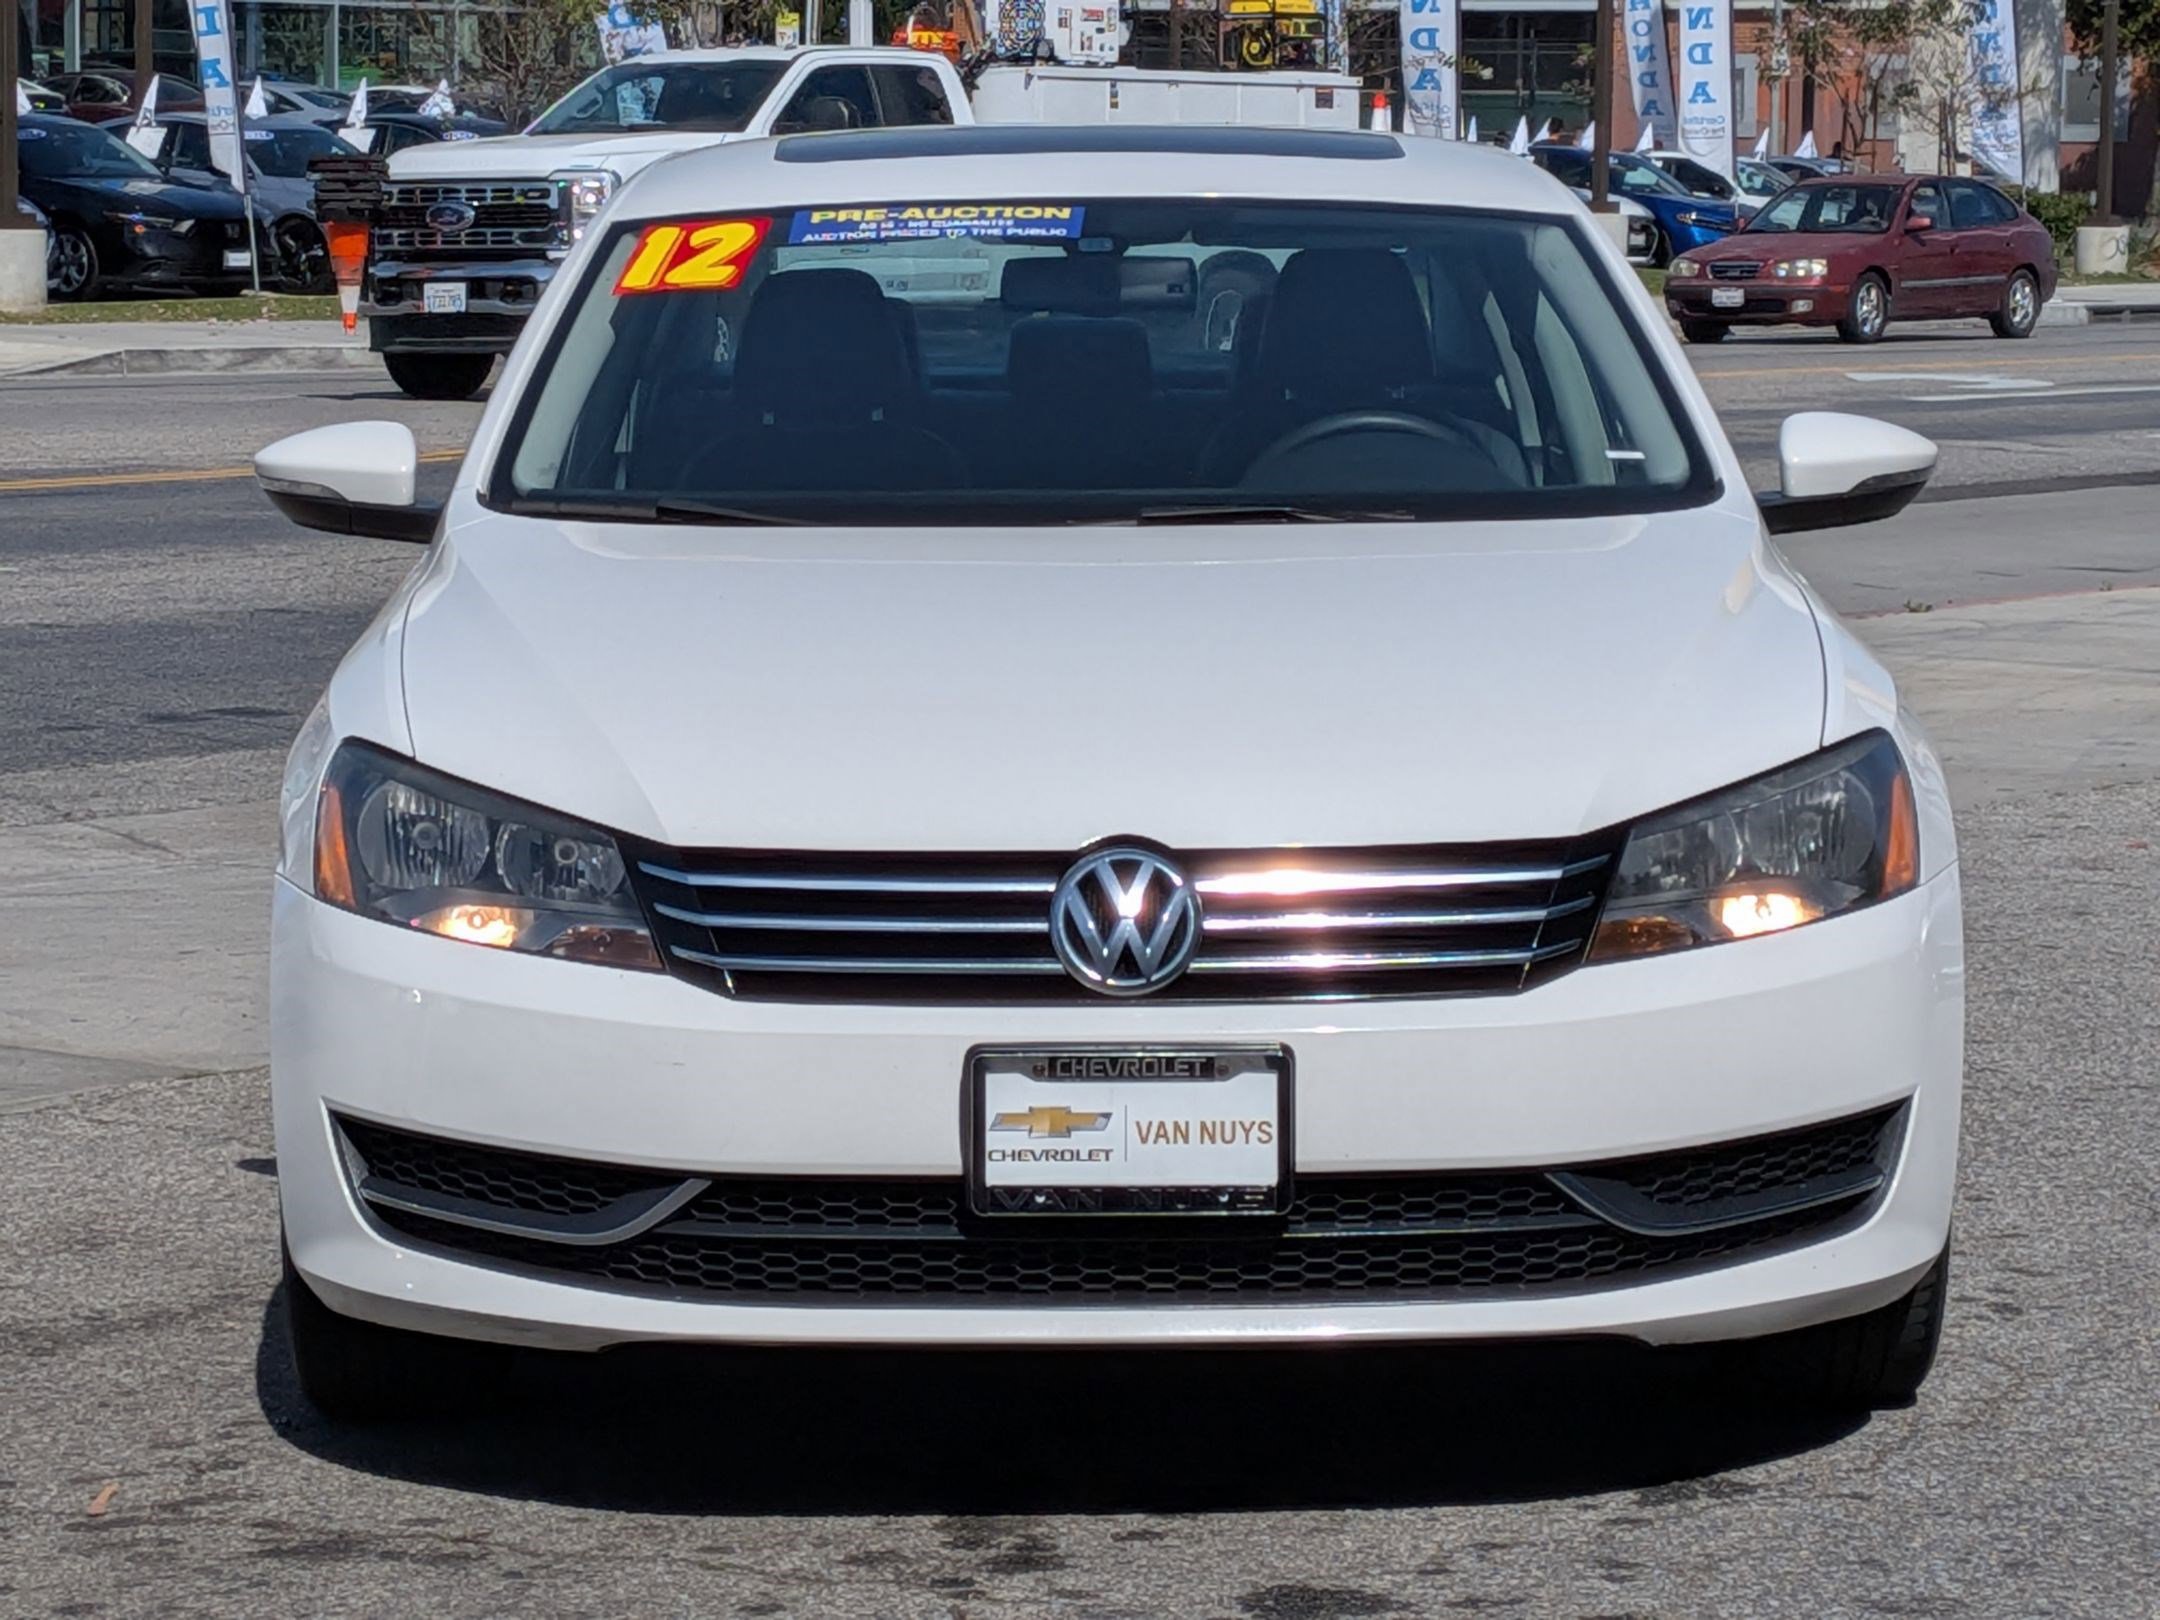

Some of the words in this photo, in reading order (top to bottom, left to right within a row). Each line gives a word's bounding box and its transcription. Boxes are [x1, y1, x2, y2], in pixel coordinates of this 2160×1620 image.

[810, 206, 1072, 223] PRE-AUCTION
[801, 231, 877, 242] AUCTION
[971, 227, 1003, 236] THE
[1006, 227, 1067, 236] PUBLIC
[620, 221, 757, 290] 12
[1056, 1058, 1206, 1077] CHEVROLET
[1136, 1120, 1190, 1145] VAN
[1200, 1120, 1273, 1145] NUYS
[988, 1149, 1114, 1162] CHEVROLET
